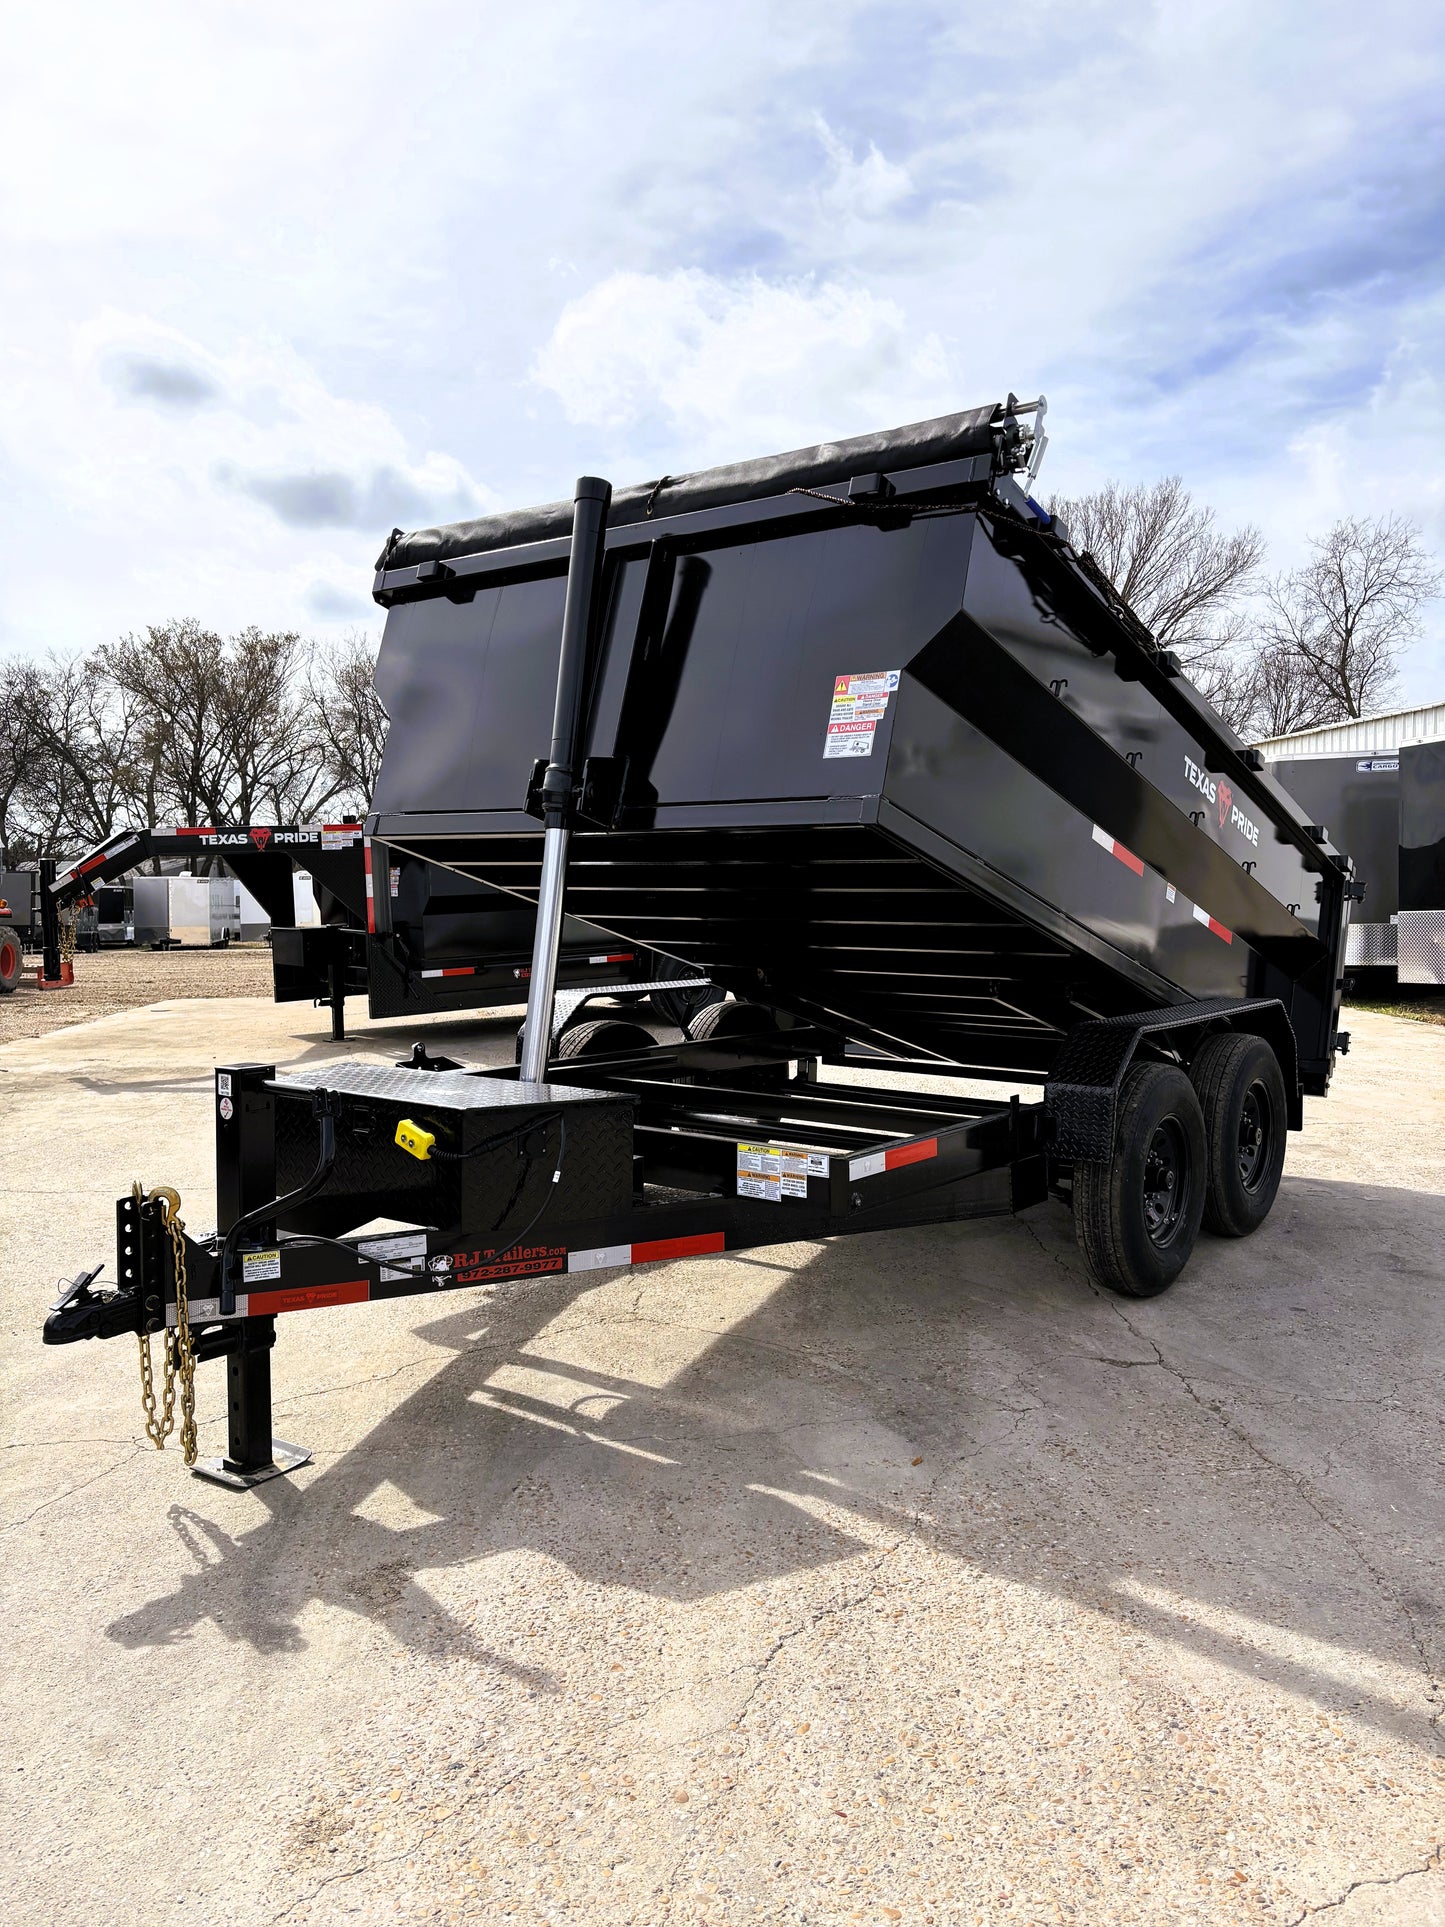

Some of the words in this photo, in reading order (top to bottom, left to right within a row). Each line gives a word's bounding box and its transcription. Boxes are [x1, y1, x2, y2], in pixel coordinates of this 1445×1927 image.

[857, 672, 885, 680] WARNING
[839, 722, 872, 732] DANGER
[1184, 754, 1217, 804] TEXAS
[1231, 804, 1259, 847] PRIDE
[199, 833, 248, 846] TEXAS
[274, 832, 319, 843] PRIDE
[752, 1146, 770, 1154] CAUTION
[252, 1252, 277, 1261] CAUTION
[461, 1260, 559, 1279] 972-287-9977
